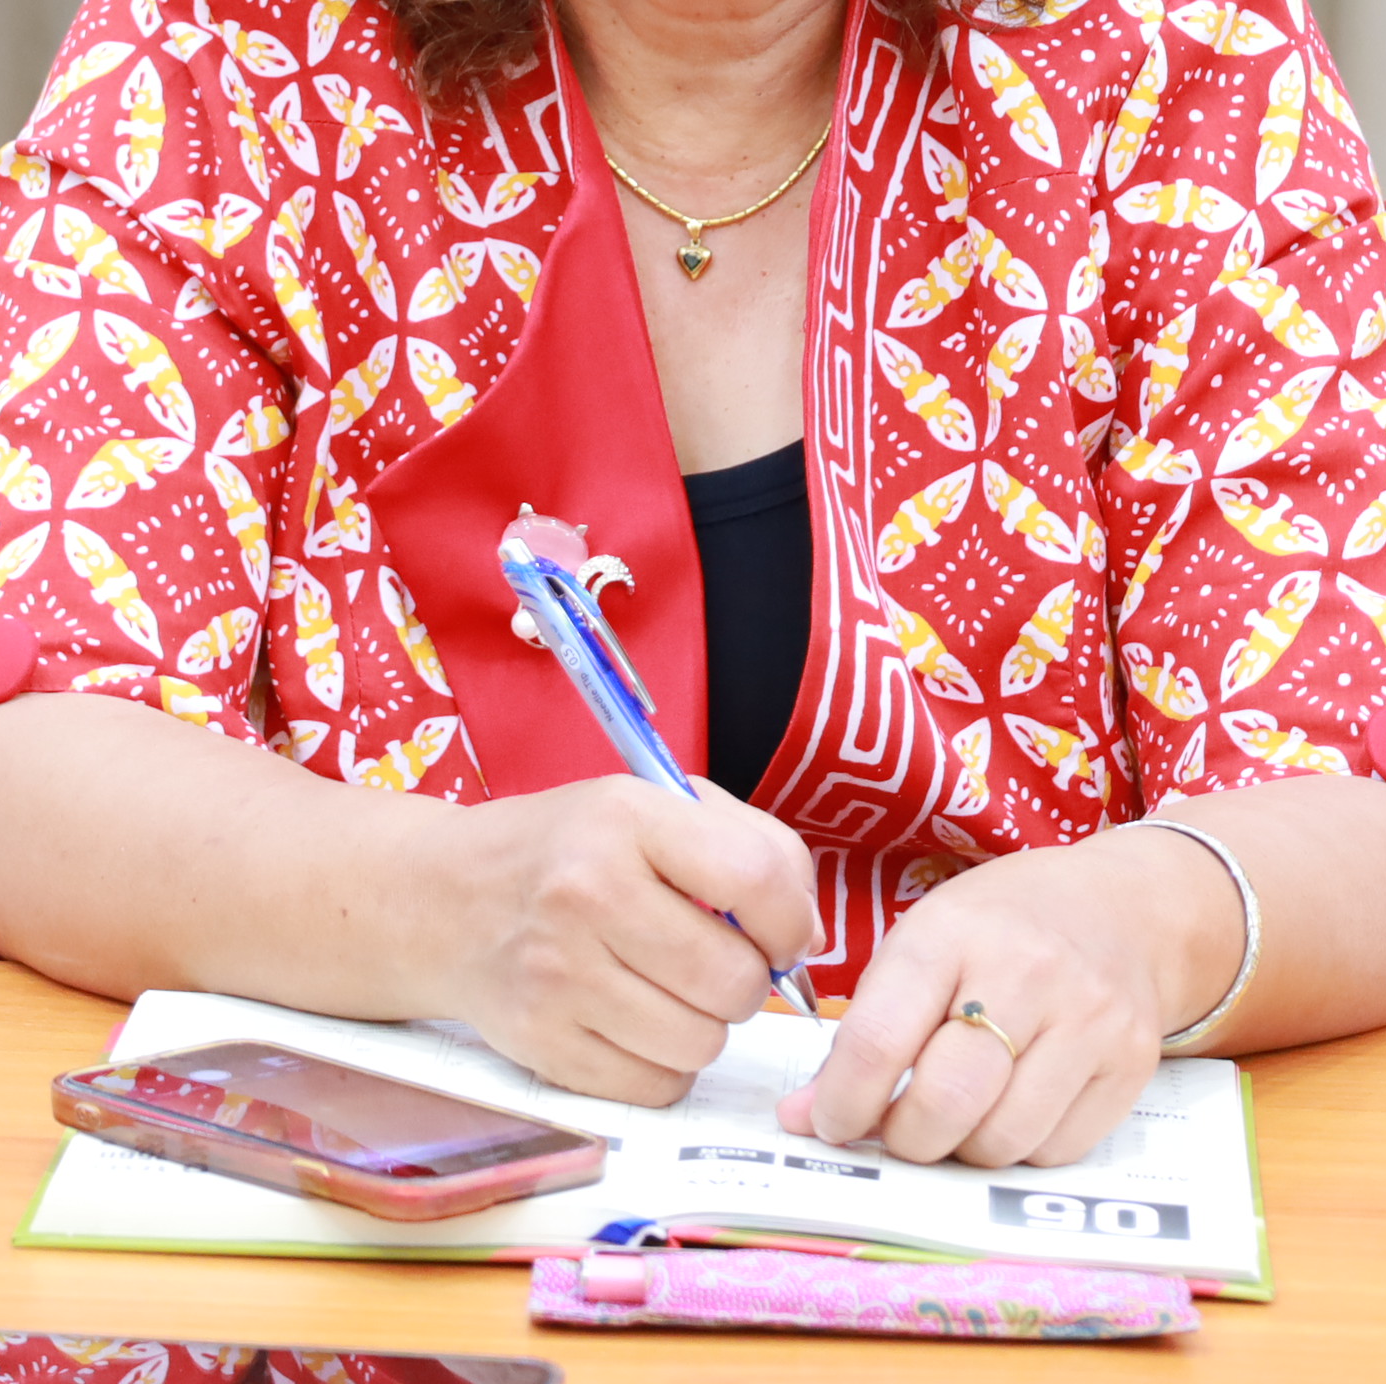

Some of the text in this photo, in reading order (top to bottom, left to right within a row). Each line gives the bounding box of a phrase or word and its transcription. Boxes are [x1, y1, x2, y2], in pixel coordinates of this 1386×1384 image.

[562, 647, 615, 722] Needle Tip 0.5
[1022, 1193, 1161, 1237] 05
